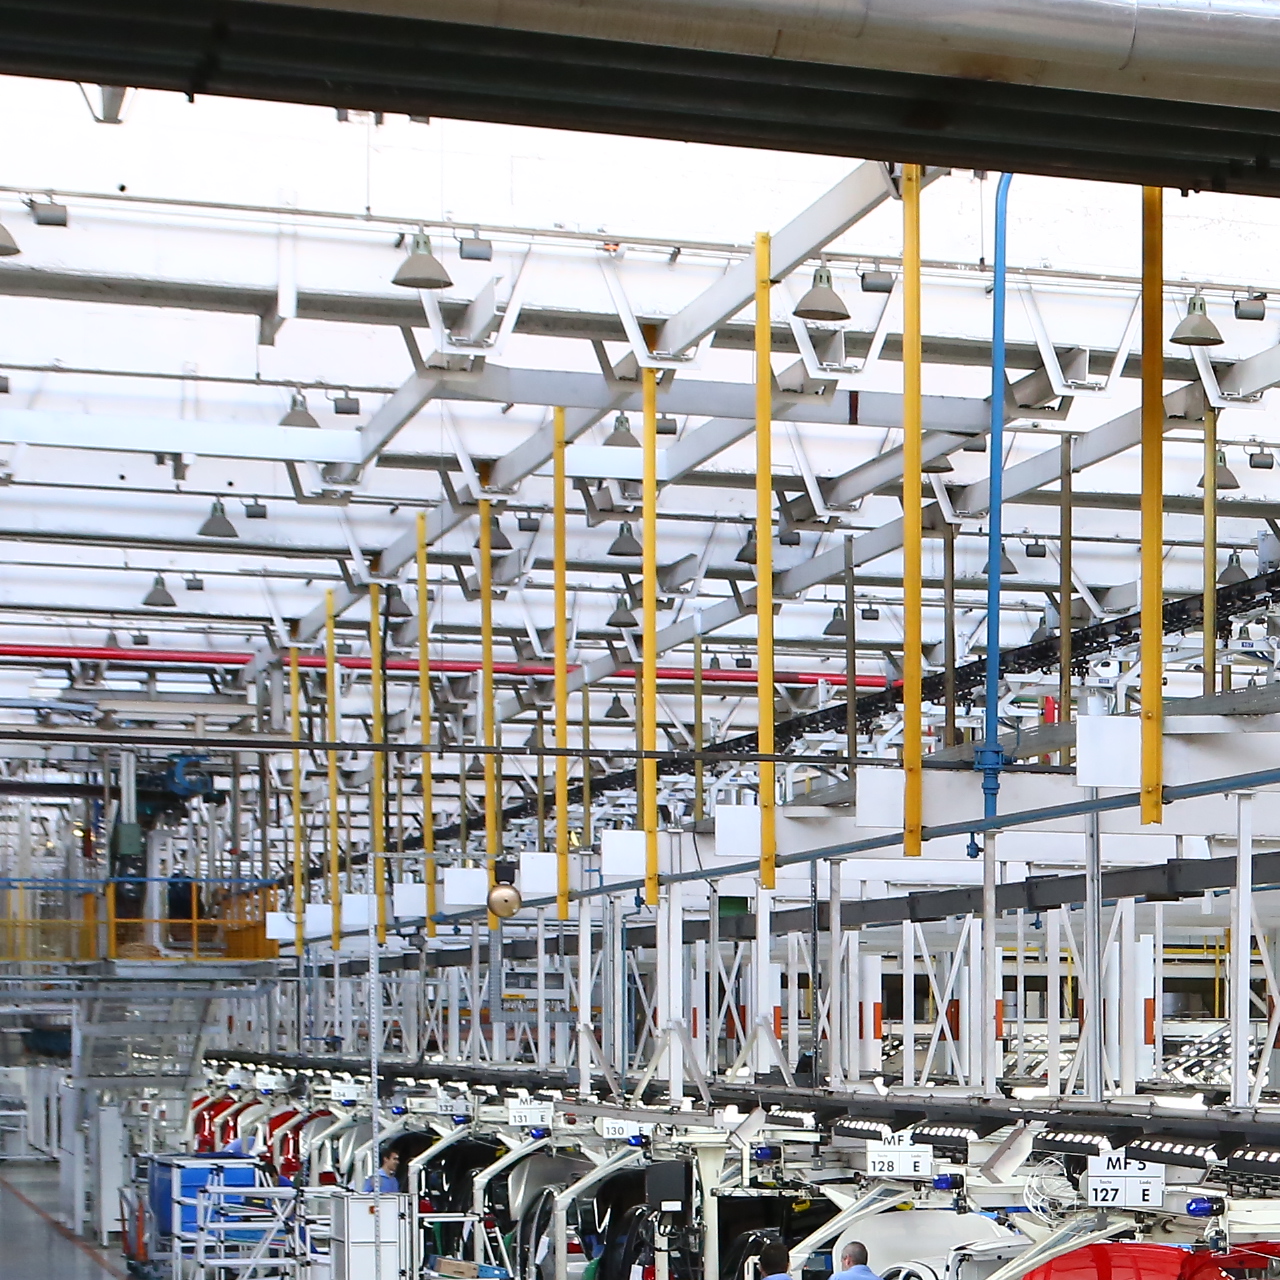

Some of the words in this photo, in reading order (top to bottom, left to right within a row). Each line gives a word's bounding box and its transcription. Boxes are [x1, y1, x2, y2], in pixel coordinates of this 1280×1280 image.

[439, 1104, 454, 1112] 132
[465, 1104, 470, 1112] E
[512, 1114, 528, 1123] 131
[540, 1114, 545, 1123] E
[606, 1126, 624, 1136] 130
[883, 1135, 905, 1146] MF
[871, 1161, 894, 1172] 128
[913, 1161, 920, 1172] E
[1106, 1157, 1132, 1171] MF
[1137, 1159, 1147, 1171] 5
[1092, 1188, 1120, 1202] 127
[1142, 1188, 1150, 1202] E
